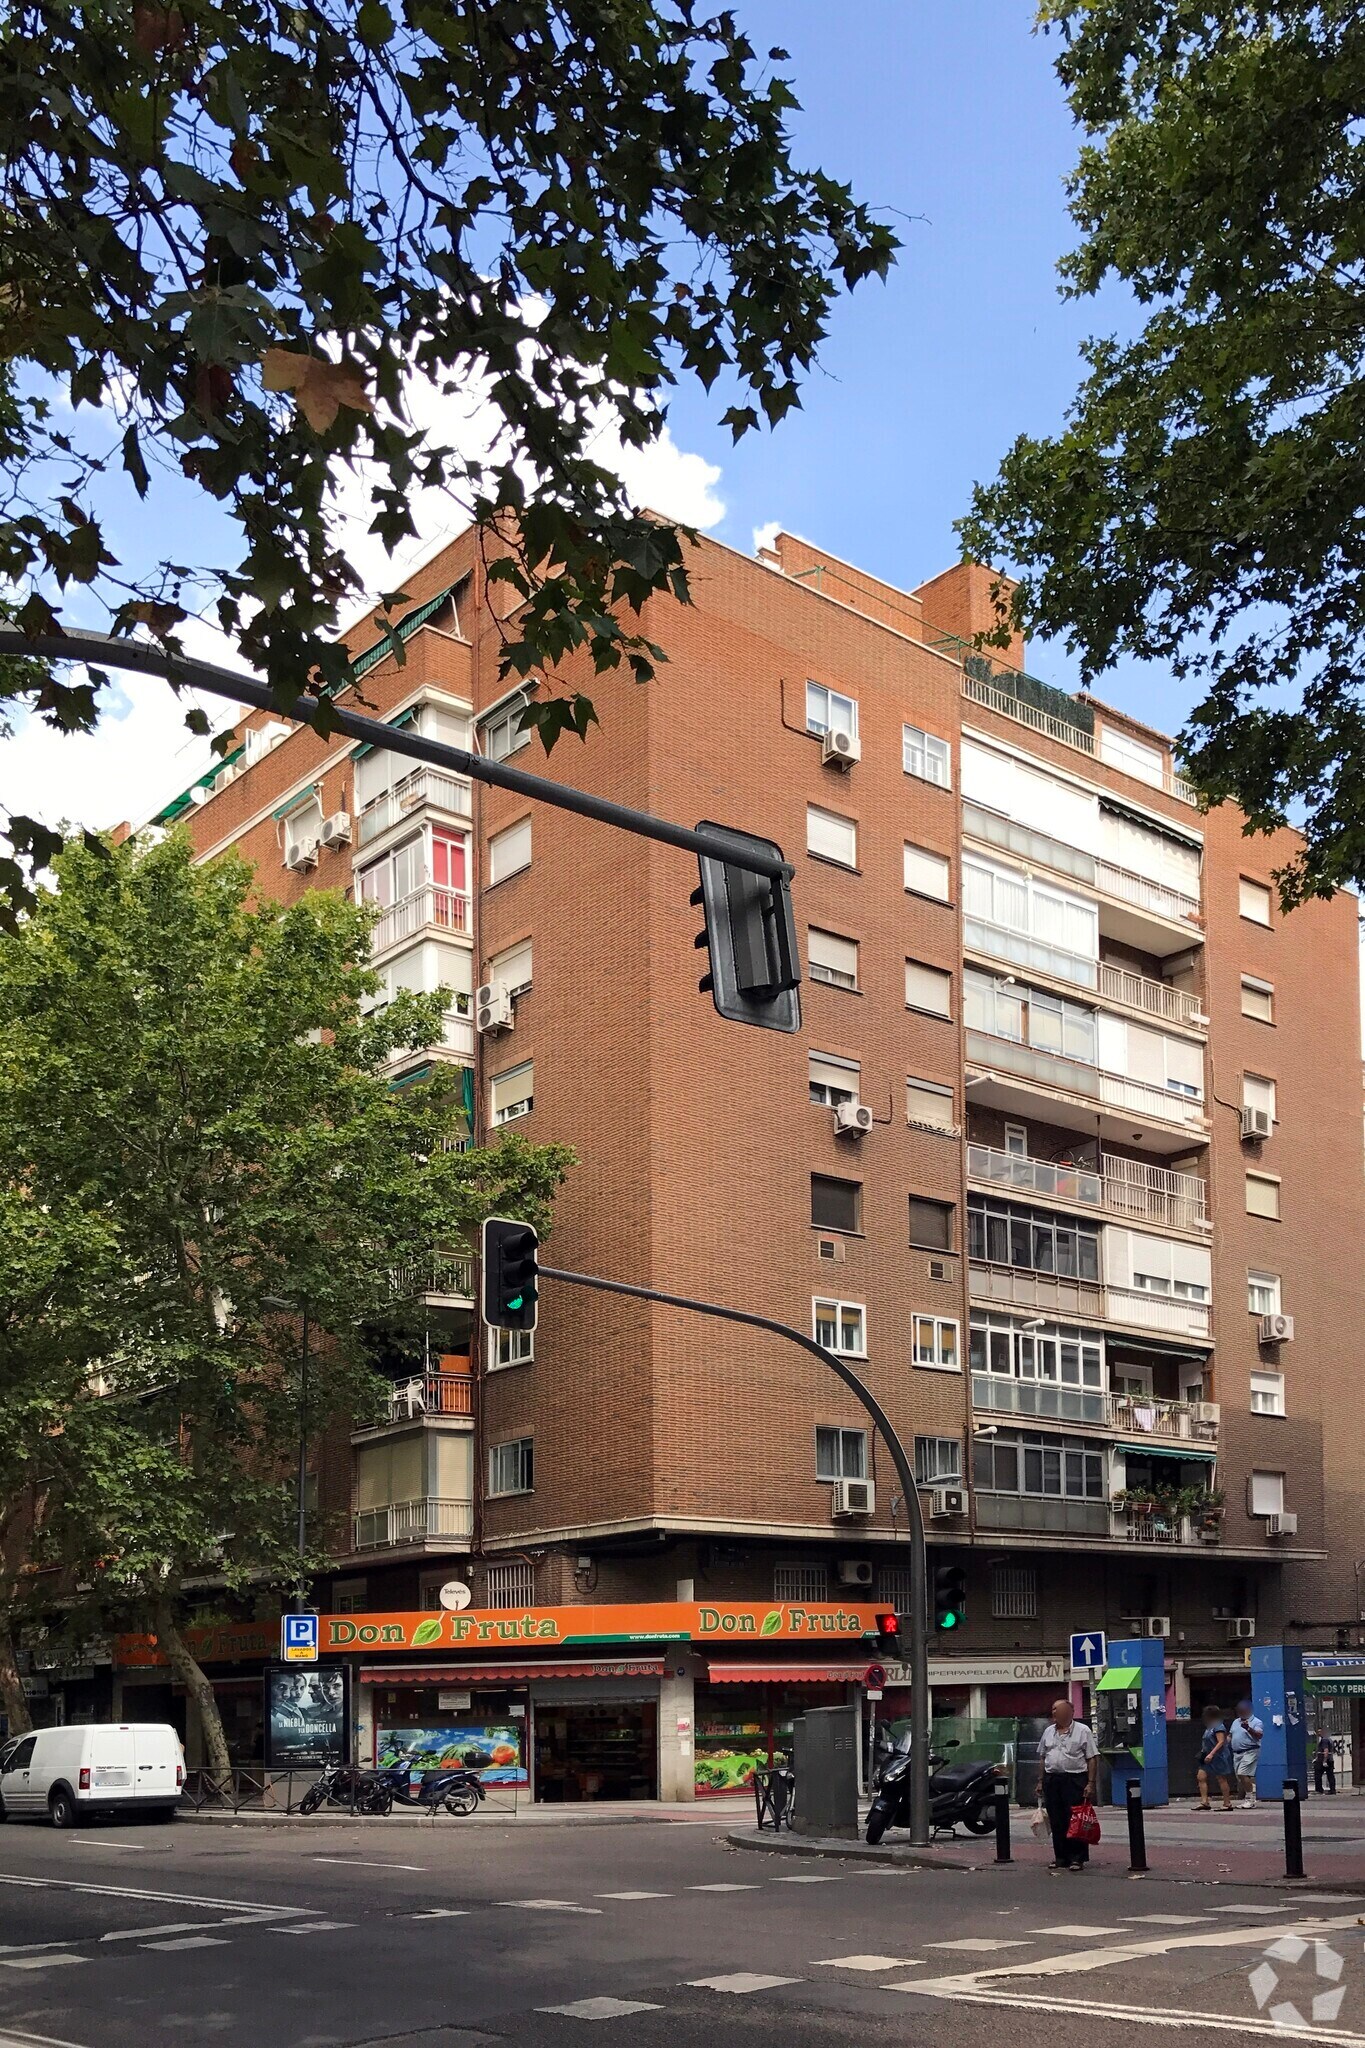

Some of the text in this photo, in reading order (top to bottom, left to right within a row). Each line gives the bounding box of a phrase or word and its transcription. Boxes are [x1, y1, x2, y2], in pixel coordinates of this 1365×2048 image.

[699, 1607, 862, 1633] Don Fruta
[295, 1622, 310, 1638] P
[329, 1614, 560, 1645] Don Fruta
[218, 1631, 266, 1655] Fruta
[592, 1664, 616, 1673] Don
[1339, 1684, 1346, 1693] Y
[283, 1717, 305, 1728] NIEBLA
[305, 1723, 337, 1733] DONCELLA
